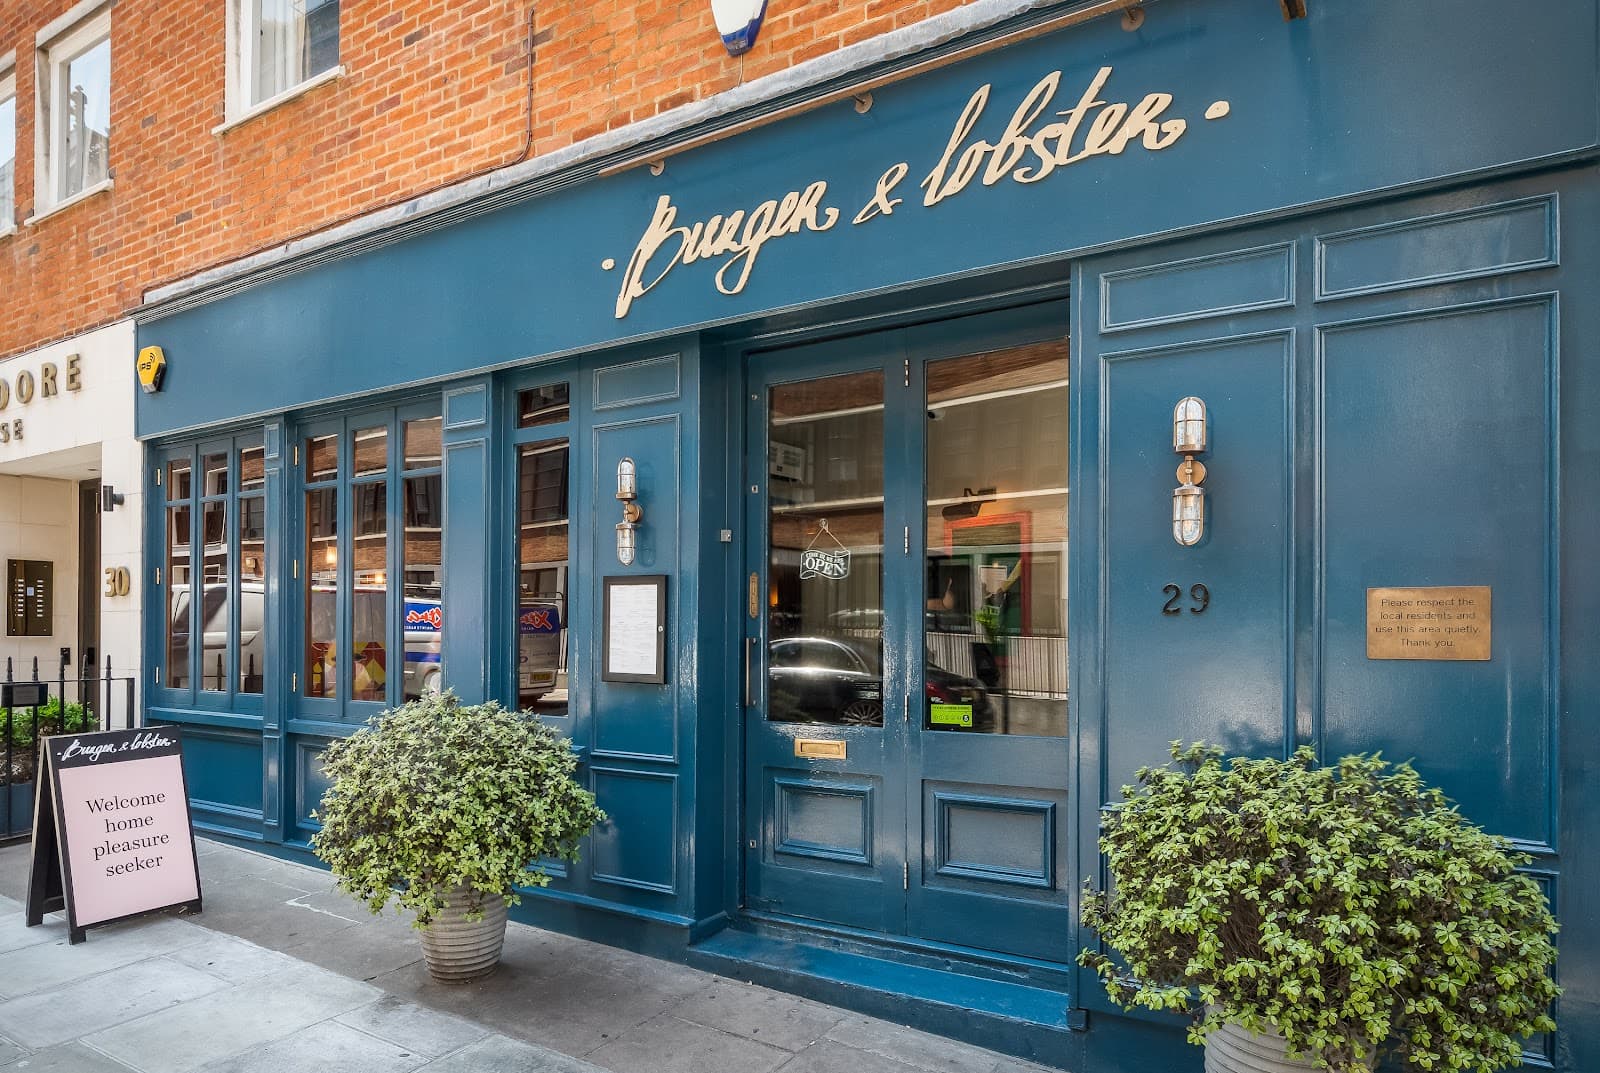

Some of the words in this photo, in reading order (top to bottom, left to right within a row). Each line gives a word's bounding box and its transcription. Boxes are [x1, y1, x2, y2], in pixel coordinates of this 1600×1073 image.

[852, 162, 909, 225] &
[805, 557, 845, 576] OPEN
[104, 566, 130, 597] 30
[1162, 583, 1209, 615] 29
[1381, 598, 1413, 607] Please
[1416, 598, 1455, 609] respect
[1458, 598, 1475, 606] the
[1380, 611, 1403, 620] local
[1406, 611, 1453, 620] residents
[1455, 611, 1476, 620] and
[1396, 625, 1415, 633] this
[1400, 638, 1431, 647] Thank
[86, 792, 167, 815] Welcome
[104, 815, 155, 833] home
[93, 833, 171, 861] pleasure
[106, 855, 164, 877] seeker
